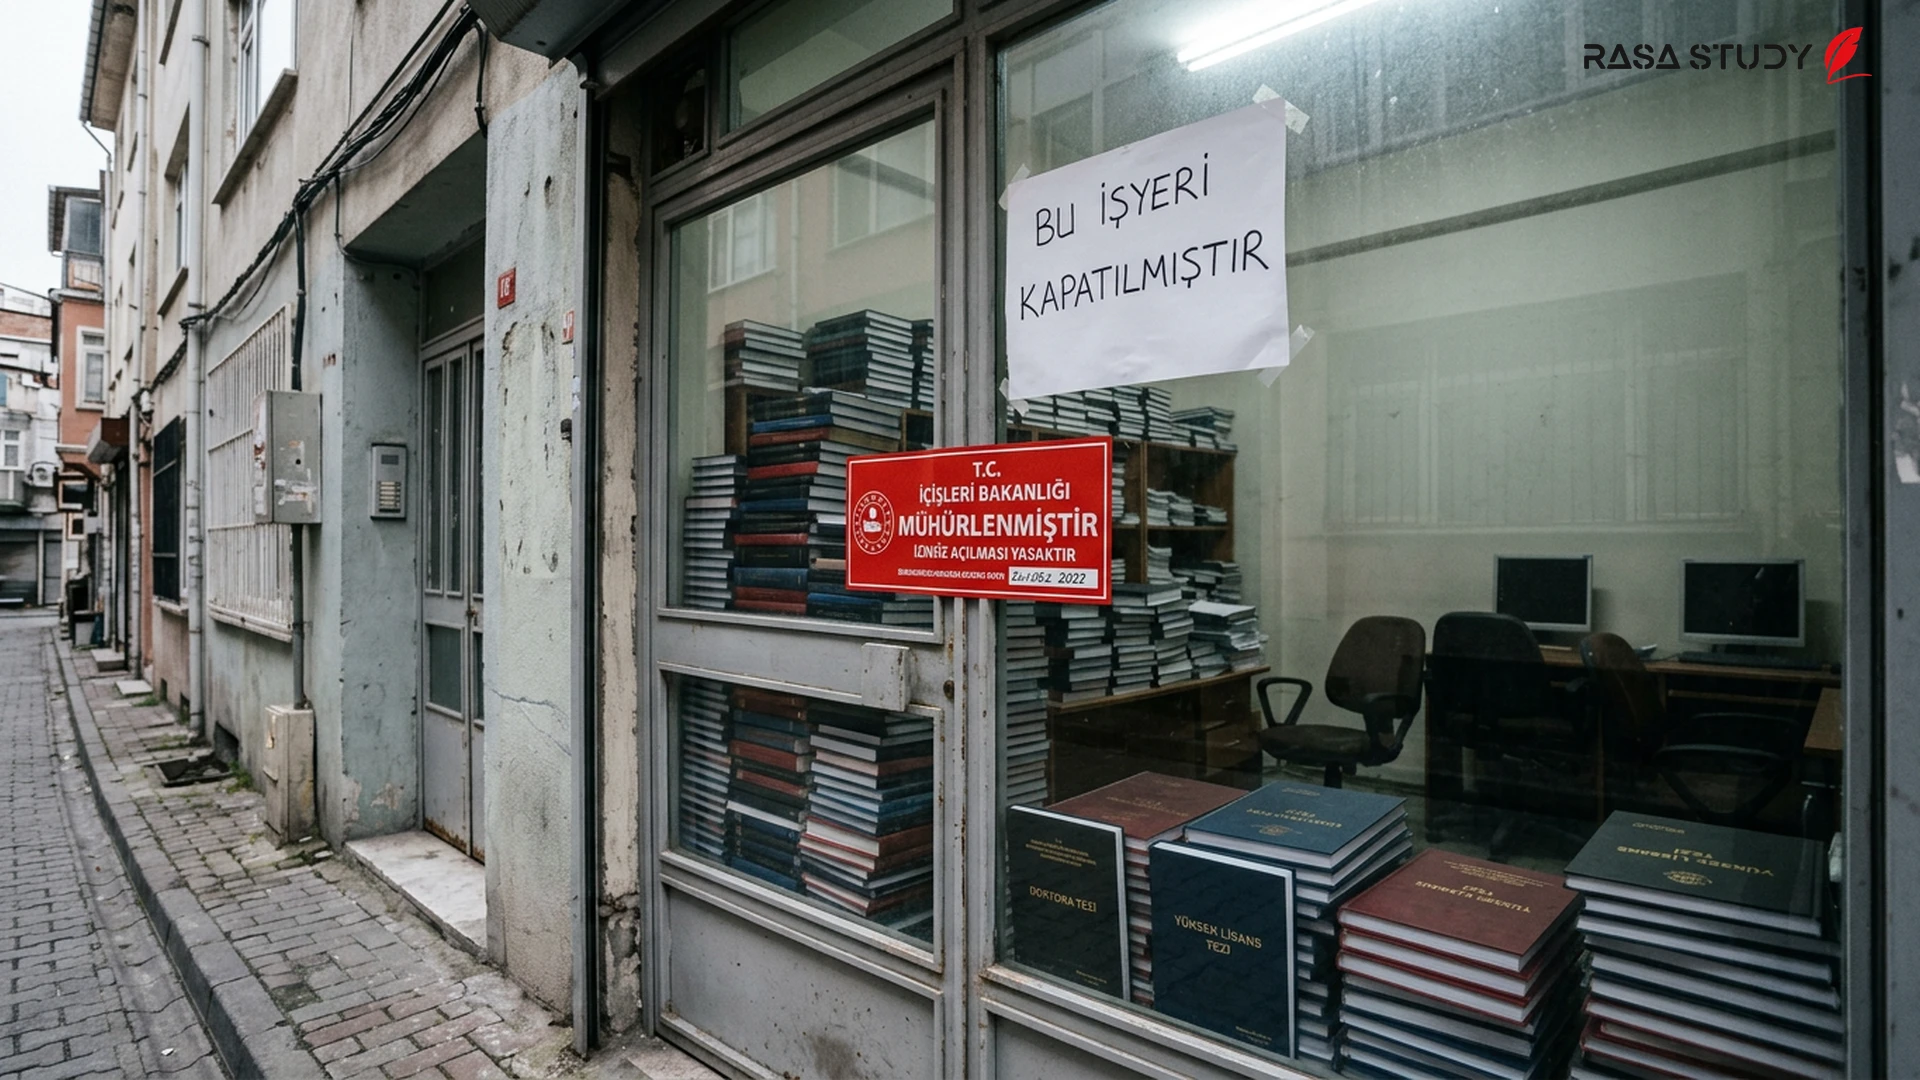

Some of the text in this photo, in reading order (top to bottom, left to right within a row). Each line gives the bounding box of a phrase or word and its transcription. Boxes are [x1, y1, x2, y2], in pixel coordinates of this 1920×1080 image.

[1036, 152, 1208, 246] BU İŞYERİ
[1021, 230, 1269, 320] KAPATILMIŞTIR
[972, 461, 1001, 478] T.C.
[919, 479, 1070, 507] İÇİŞLERİ BAKANLIĞI
[898, 507, 1098, 543] MÜHÜRLENMİŞTİR
[951, 546, 1008, 561] AÇILMASI
[1011, 547, 1076, 562] YASAKTIR
[1058, 572, 1086, 585] 2022
